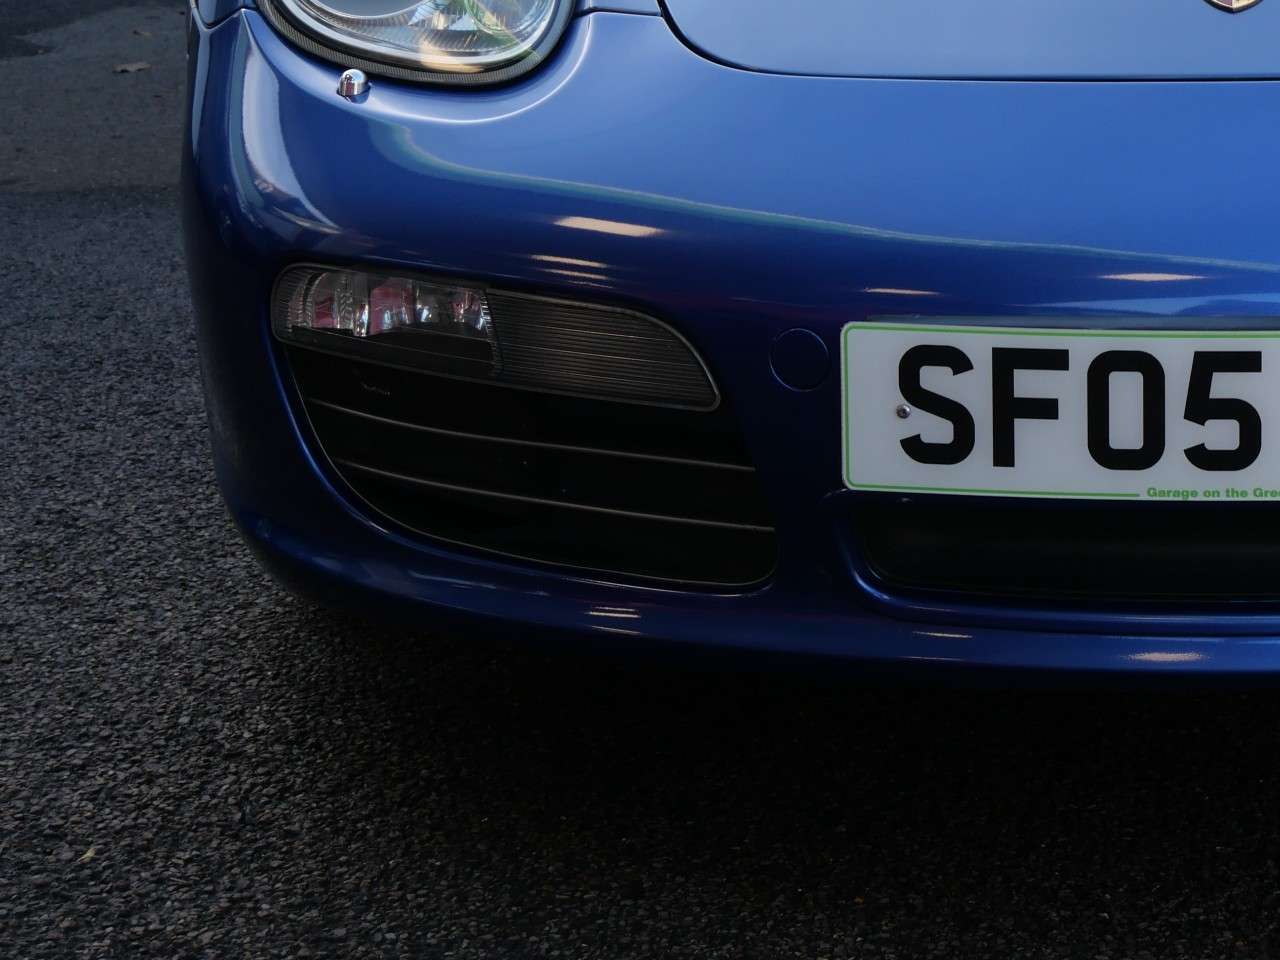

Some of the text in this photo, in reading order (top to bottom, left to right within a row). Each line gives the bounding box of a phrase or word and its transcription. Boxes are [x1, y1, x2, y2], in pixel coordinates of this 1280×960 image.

[898, 344, 1263, 471] SF05
[1147, 487, 1199, 500] Garage
[1203, 489, 1220, 498] on
[1225, 487, 1249, 498] the
